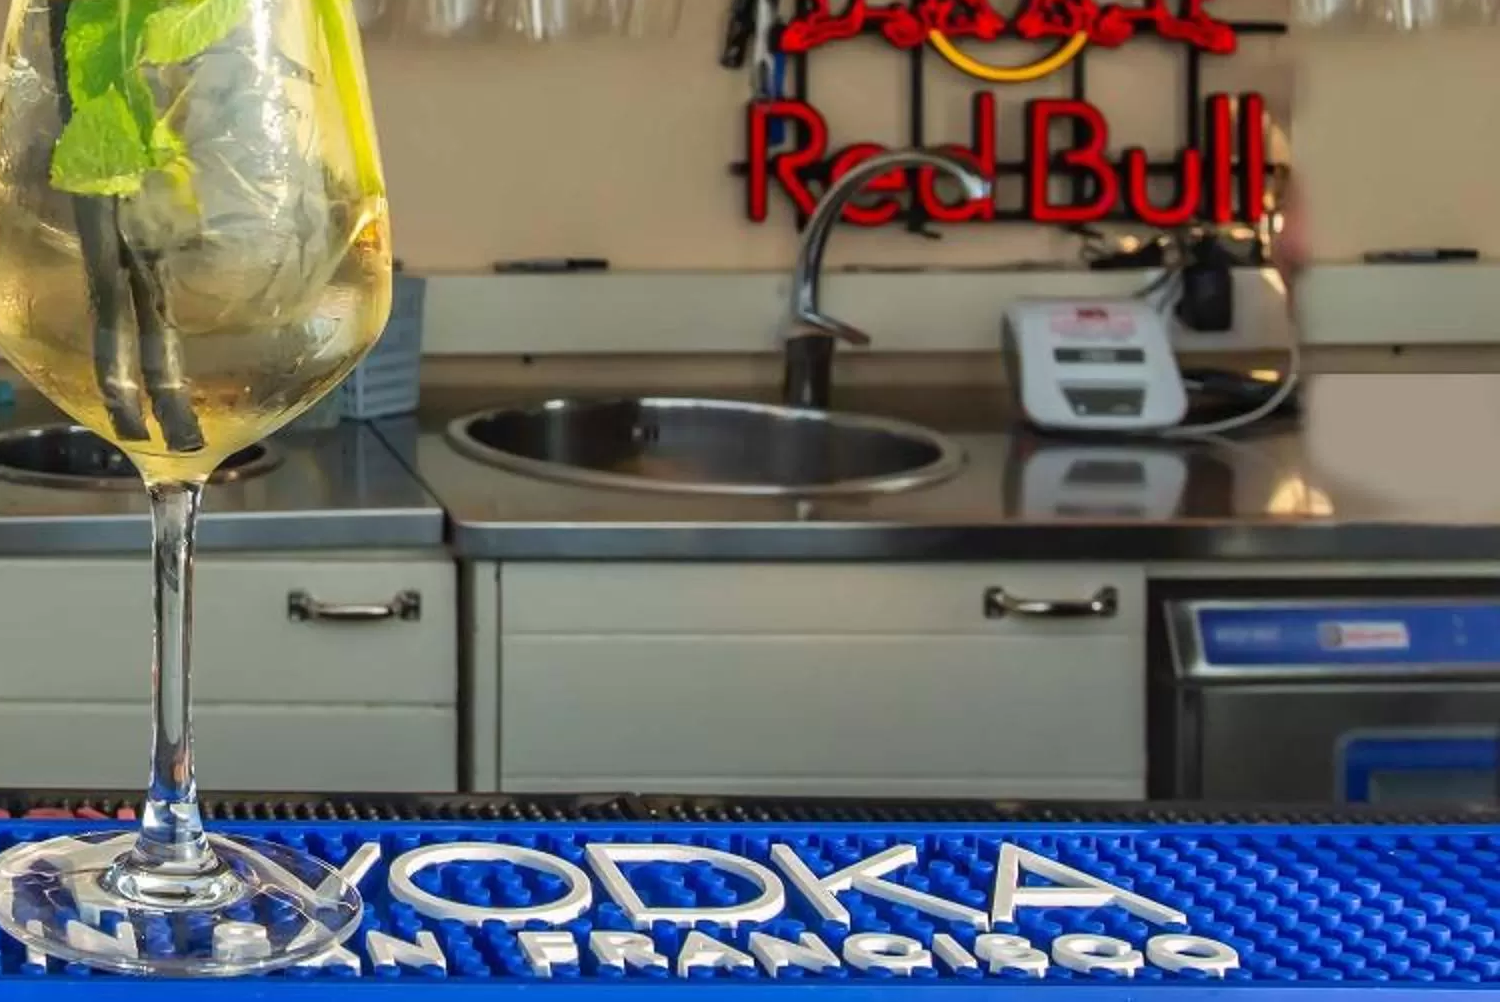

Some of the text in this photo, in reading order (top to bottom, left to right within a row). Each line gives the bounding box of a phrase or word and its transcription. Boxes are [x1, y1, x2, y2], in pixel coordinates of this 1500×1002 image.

[748, 91, 1265, 226] Red Bull
[202, 832, 1188, 932] VODKA
[517, 930, 1241, 979] FRANCISCO
